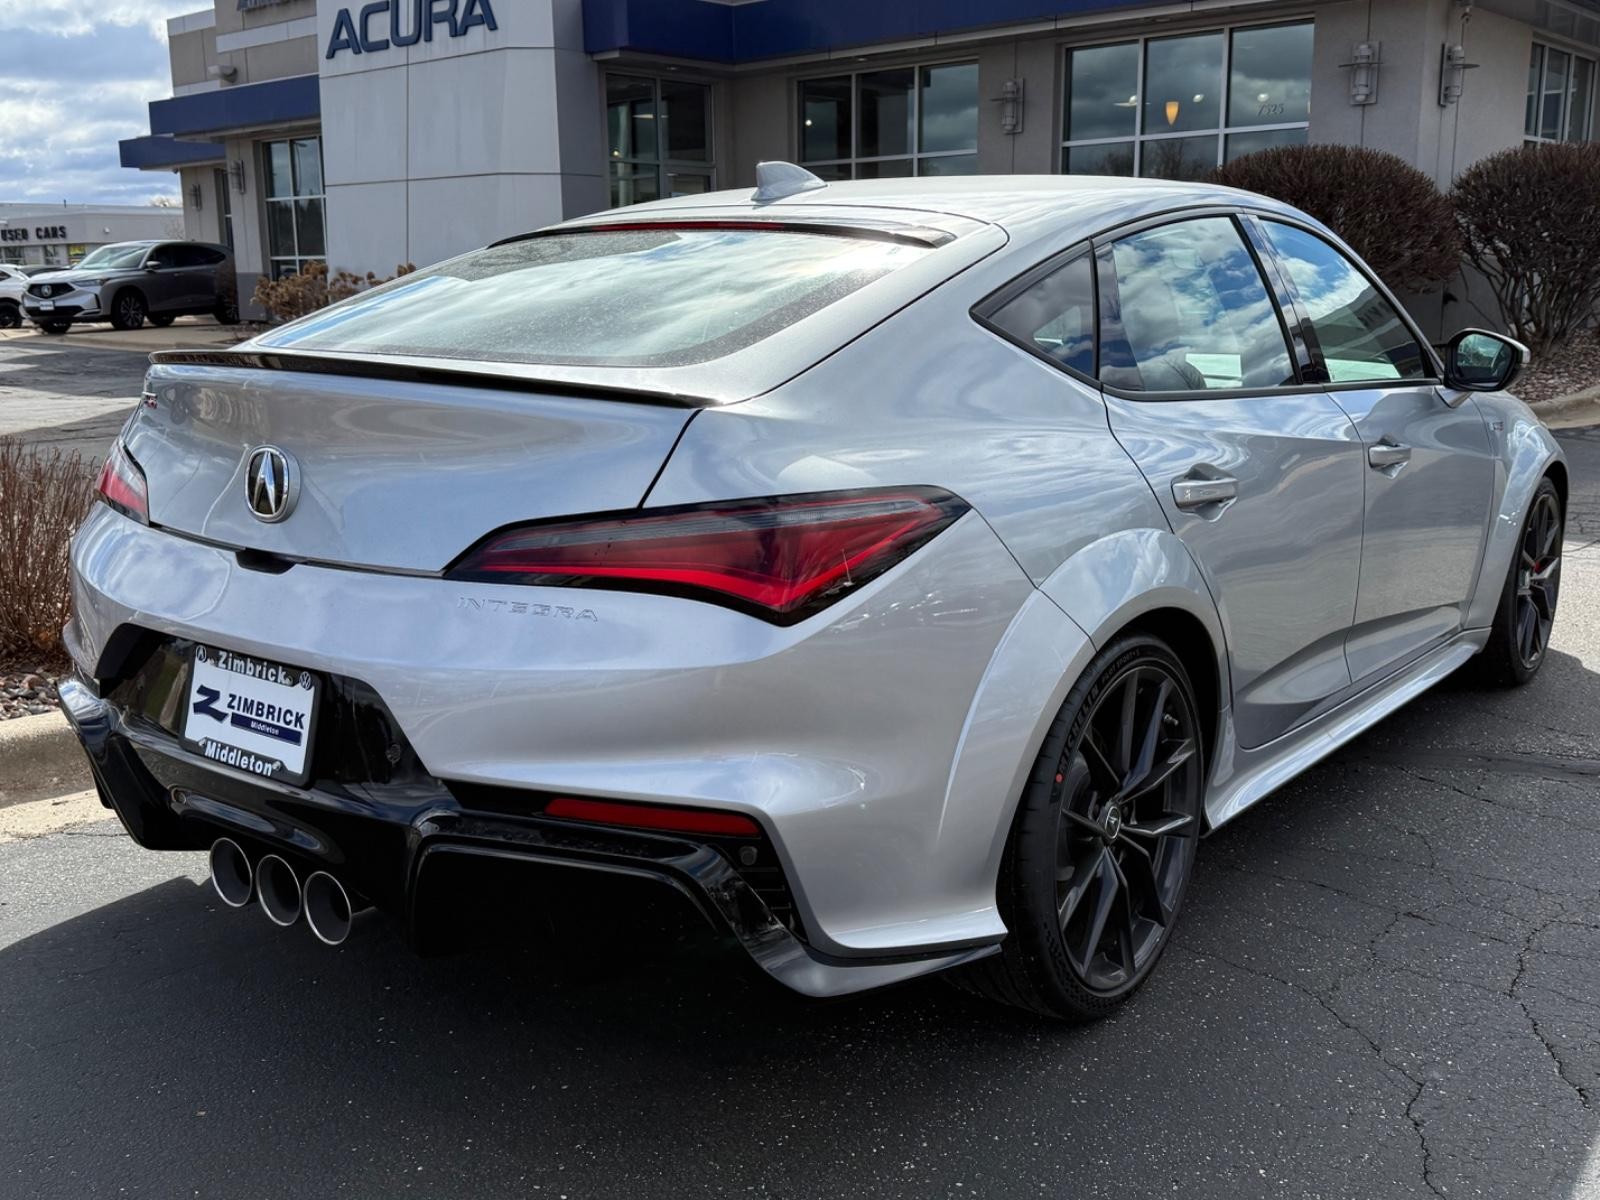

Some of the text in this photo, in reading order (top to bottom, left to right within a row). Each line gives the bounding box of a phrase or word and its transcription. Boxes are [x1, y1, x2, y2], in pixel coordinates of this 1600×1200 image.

[326, 0, 498, 59] ACURA
[1, 226, 67, 241] USED CARS
[457, 597, 598, 622] INTEGRA
[218, 651, 287, 684] Zimbrick
[227, 693, 306, 730] ZIMBRICK
[250, 721, 280, 735] Middleton
[1059, 680, 1100, 772] MICHELIN
[205, 741, 273, 777] Middleton
